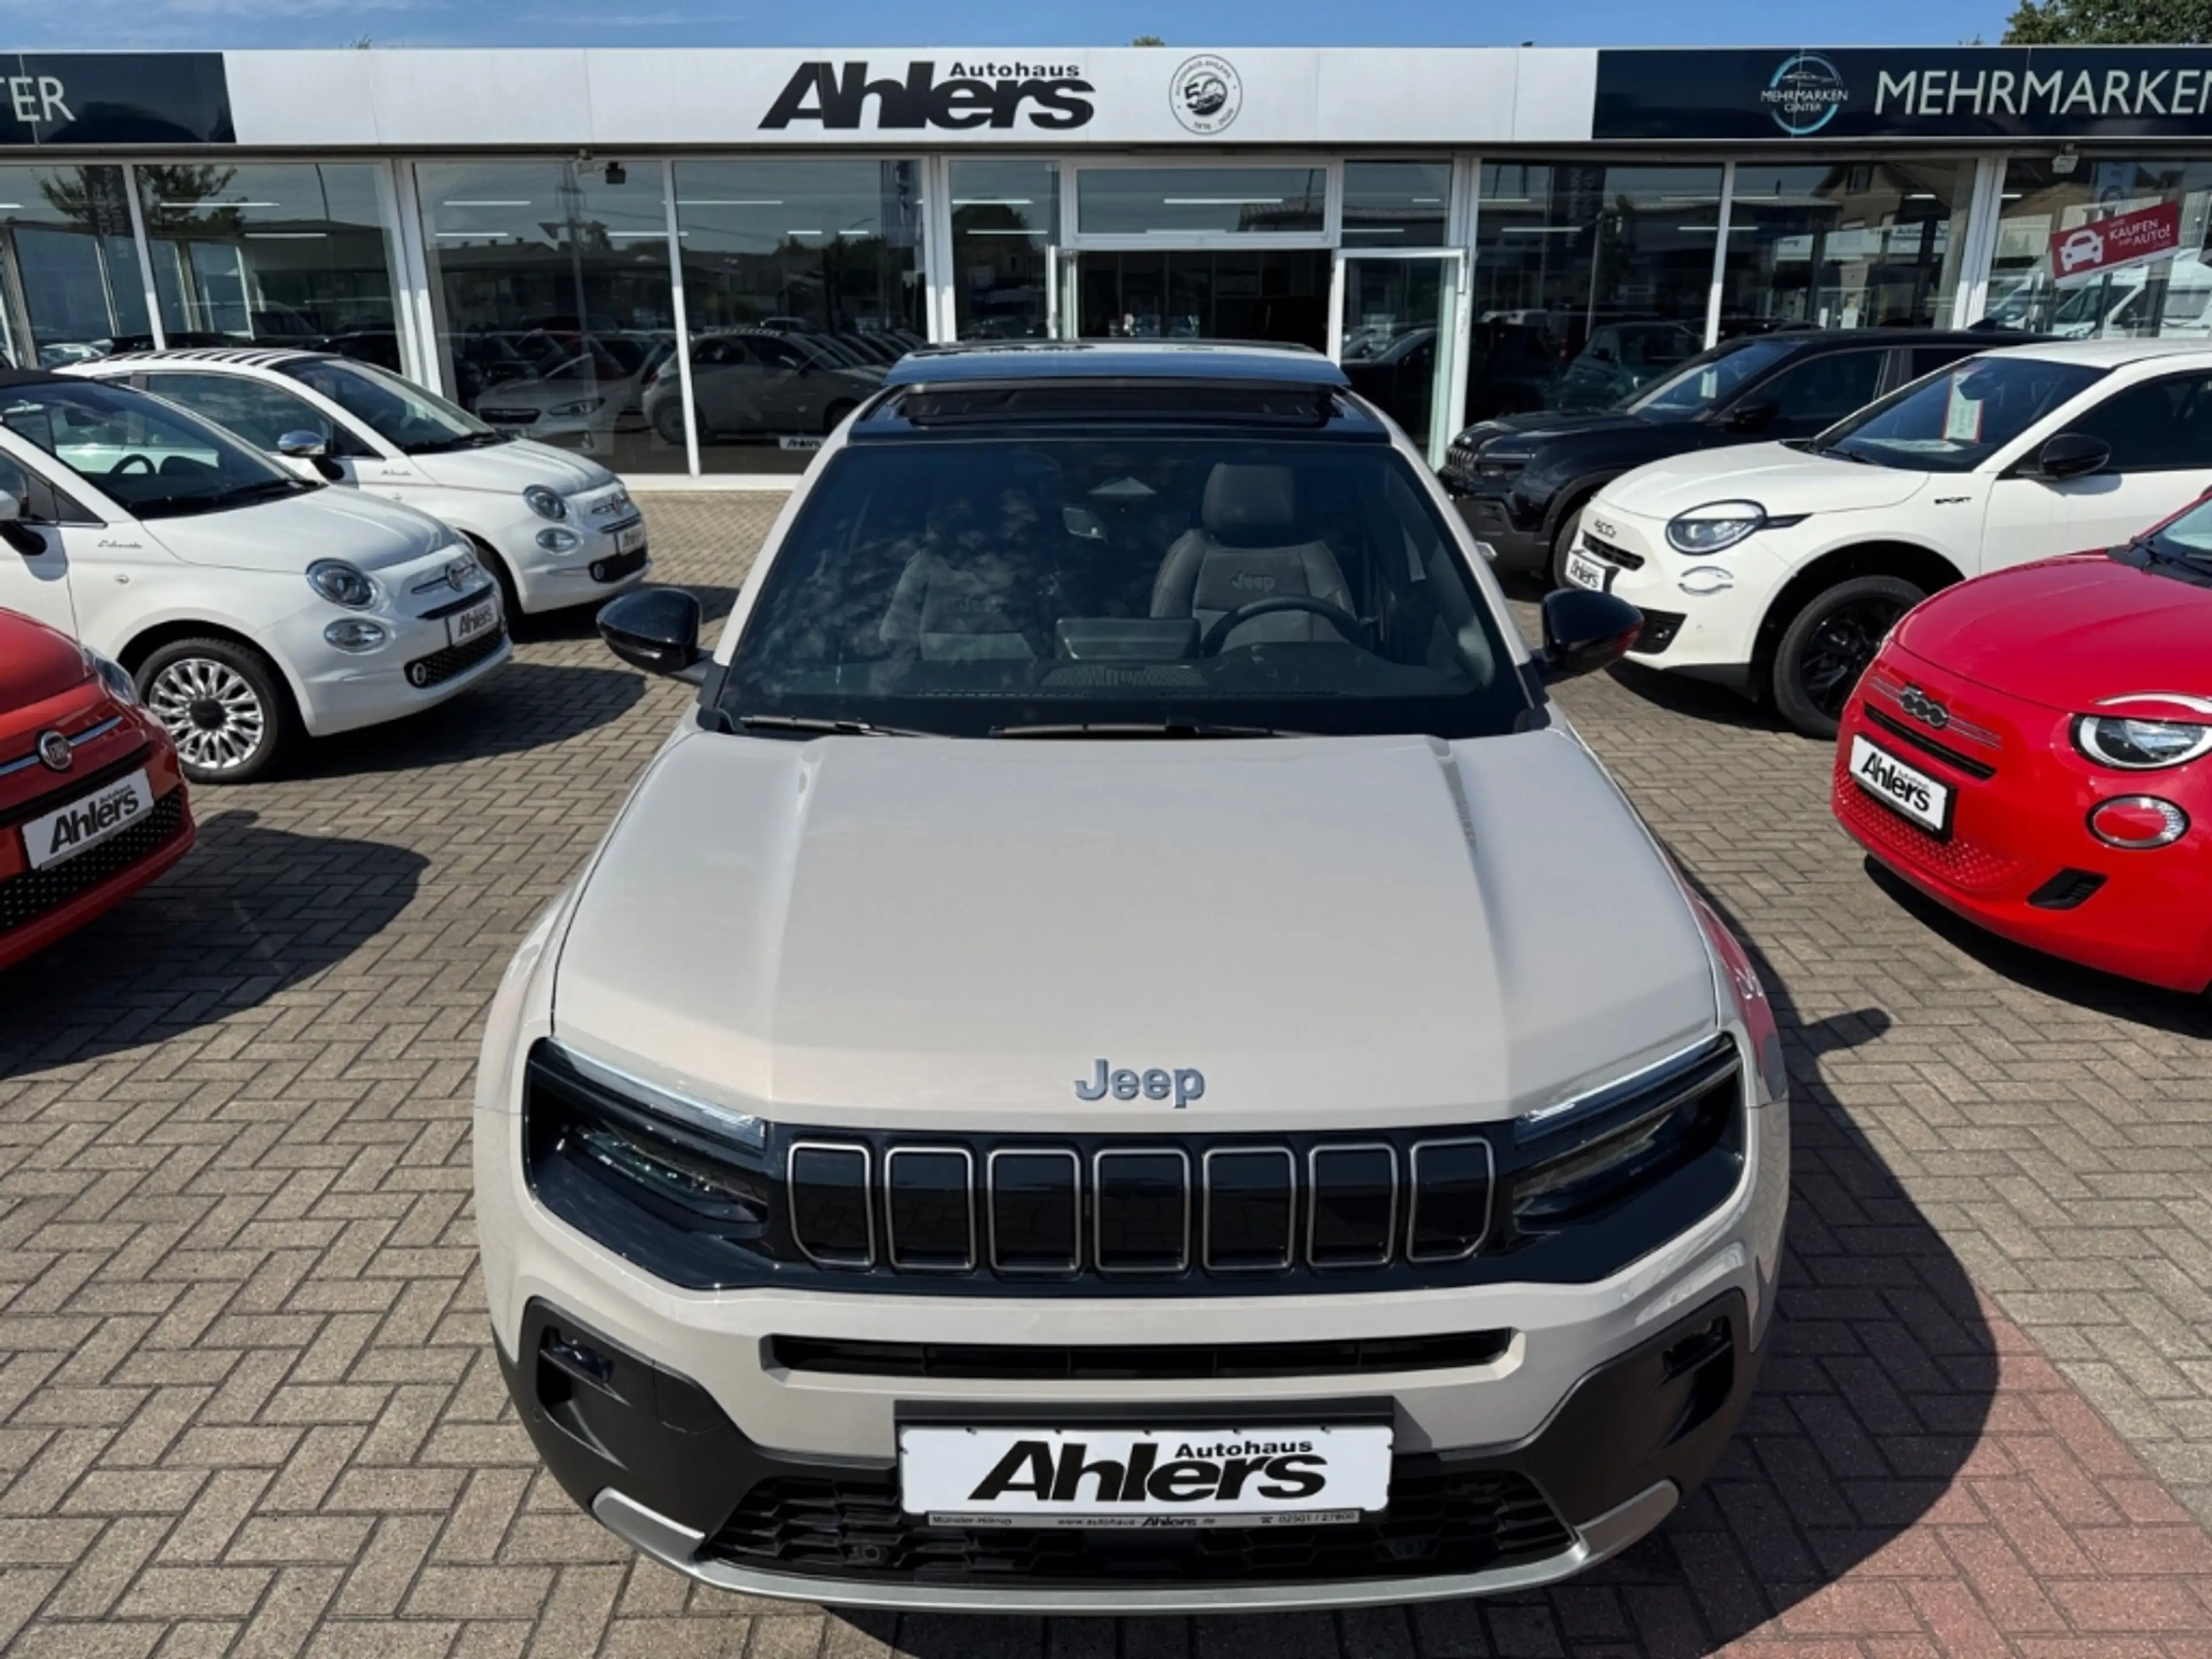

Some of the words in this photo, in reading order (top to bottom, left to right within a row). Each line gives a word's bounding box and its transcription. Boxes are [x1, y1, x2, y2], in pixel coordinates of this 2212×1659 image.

[949, 62, 1081, 78] Autohaus
[0, 77, 77, 122] ER
[757, 60, 1096, 130] Ahlers
[1760, 89, 1849, 102] MEHRMARKEN
[2109, 218, 2159, 241] KAUFEN
[2133, 223, 2171, 247] AUTO!
[1230, 571, 1276, 593] Jeep
[1861, 751, 1931, 812] Ahlers
[50, 789, 139, 854] Ahlers
[1073, 1058, 1206, 1109] Jeep
[1175, 1440, 1313, 1459] Autohaus
[967, 1440, 1328, 1502] Ahlers
